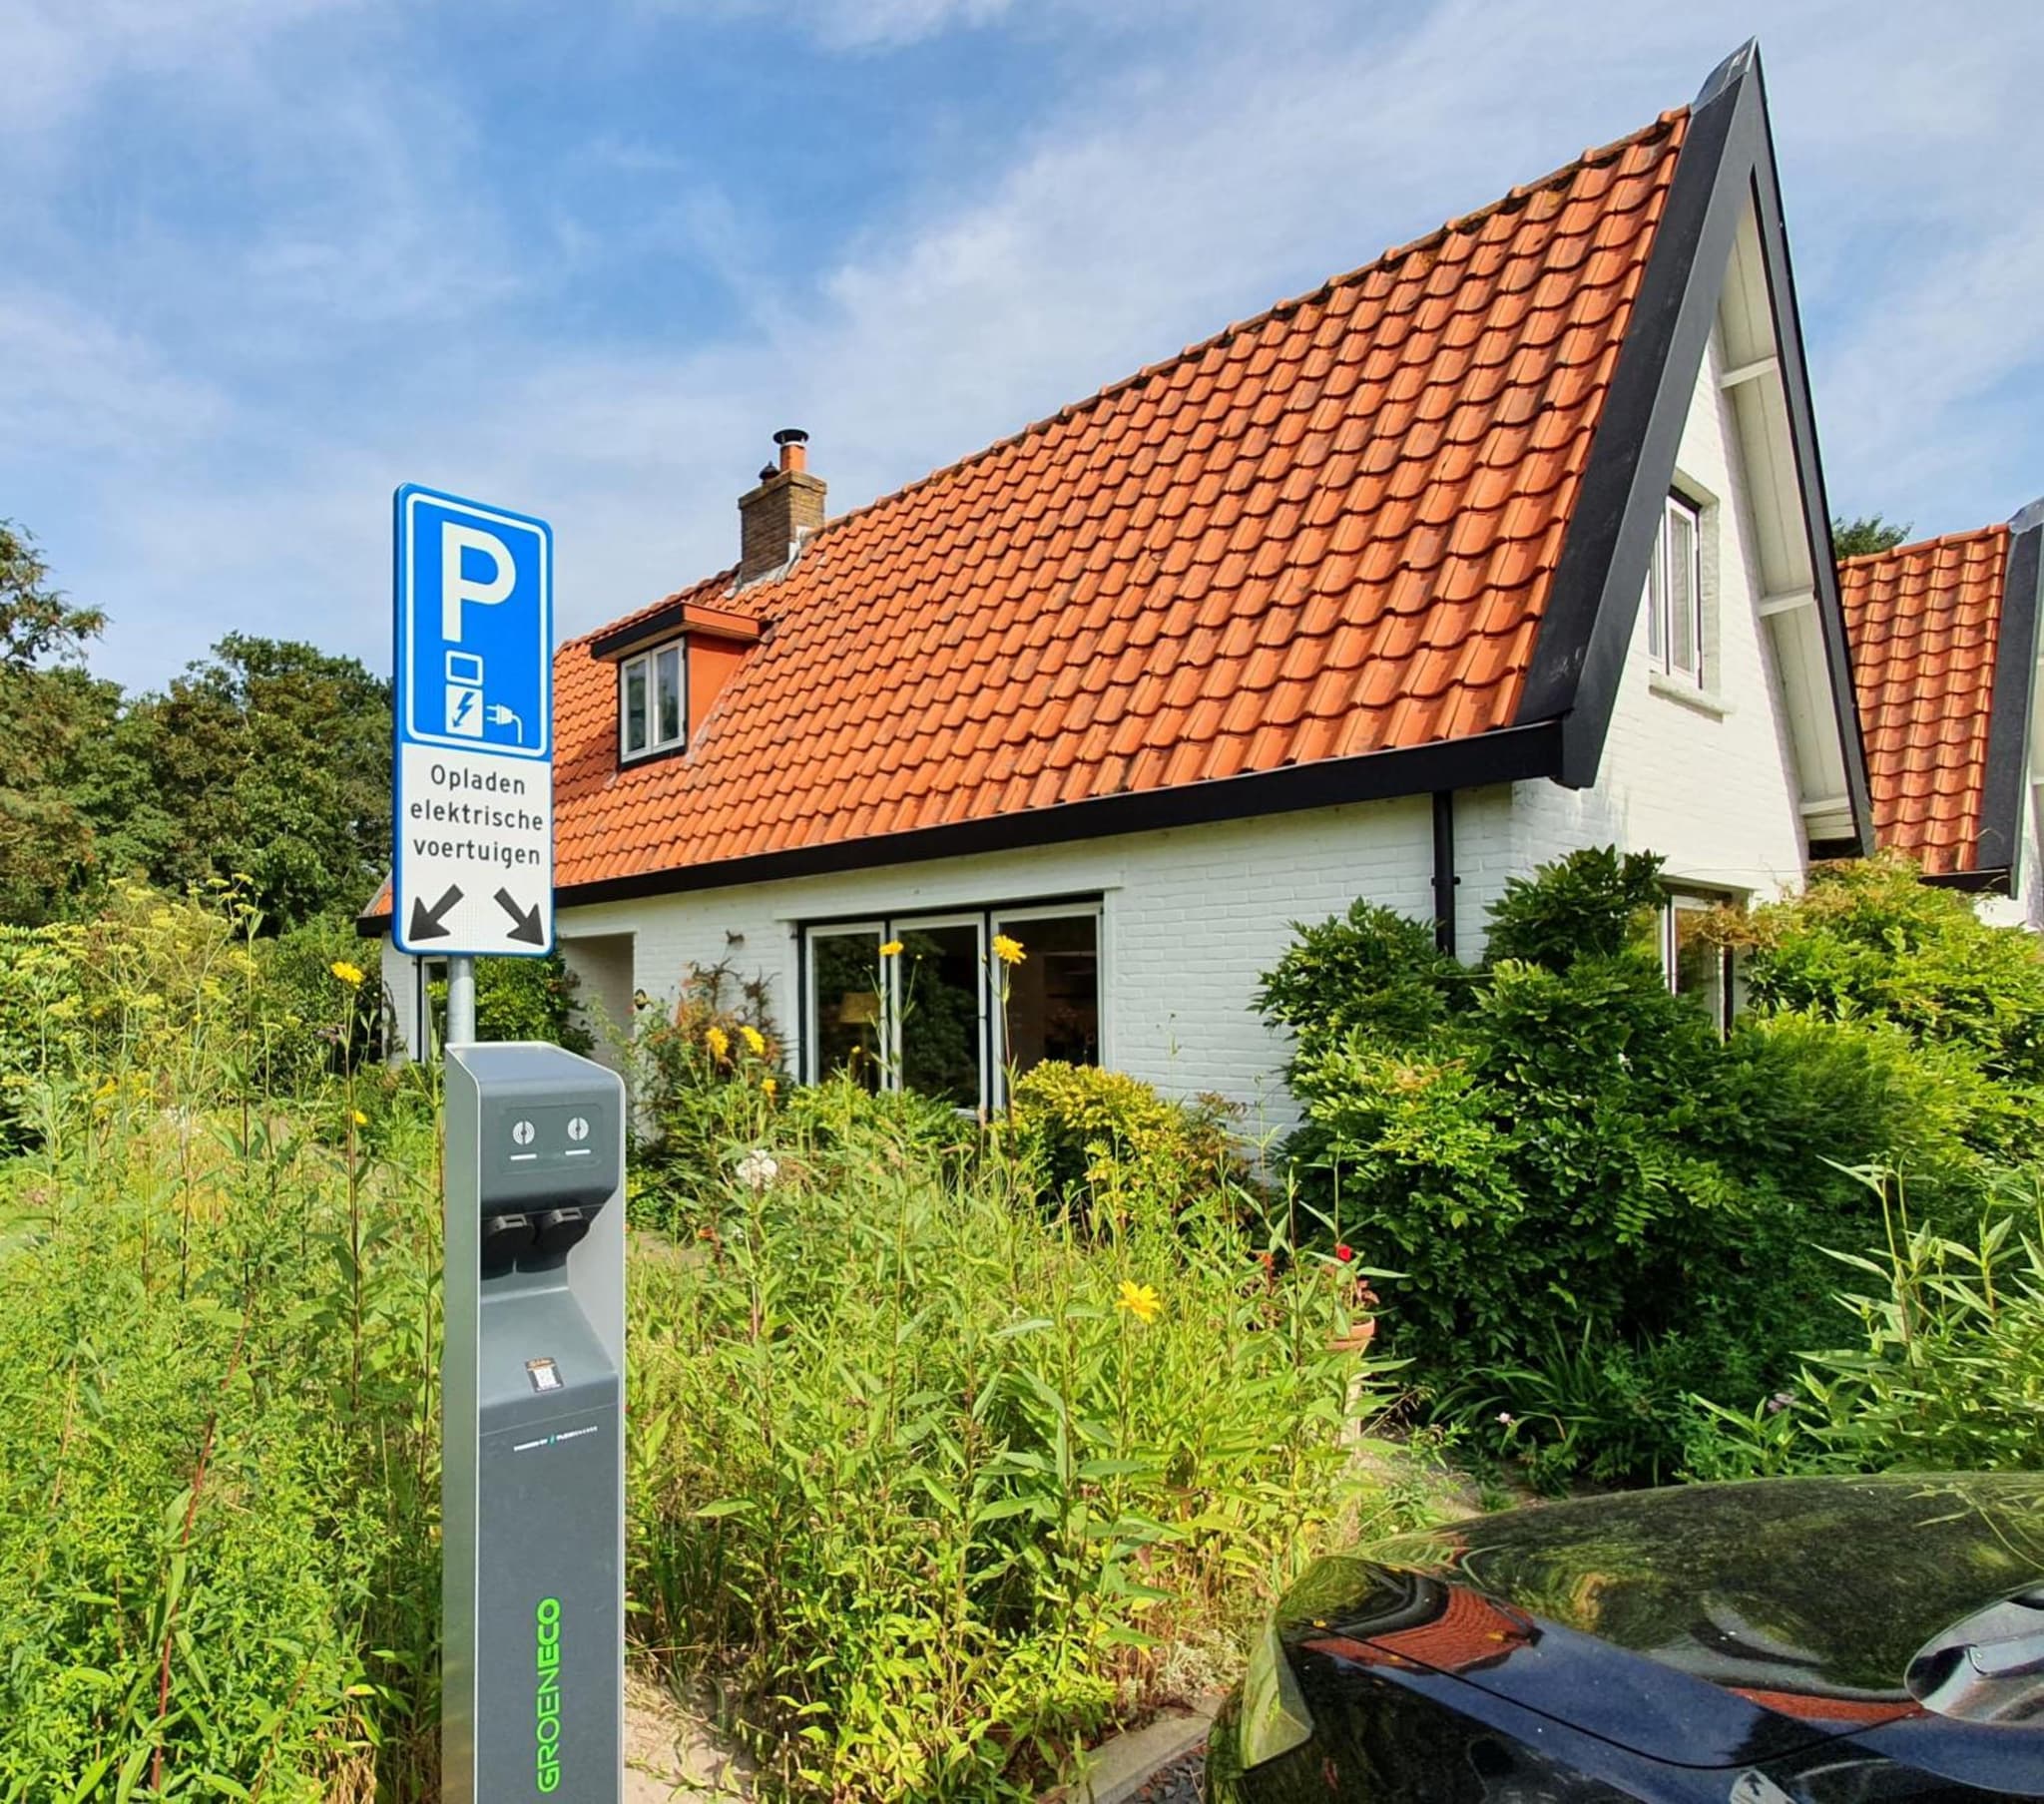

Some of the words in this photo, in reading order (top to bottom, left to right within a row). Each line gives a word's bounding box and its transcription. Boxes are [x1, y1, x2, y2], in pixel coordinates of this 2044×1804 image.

[441, 520, 517, 644] P
[430, 763, 525, 795] Opladen
[410, 798, 543, 831] elektrische
[413, 838, 541, 869] voertuigen
[536, 1596, 562, 1793] GROENECO
